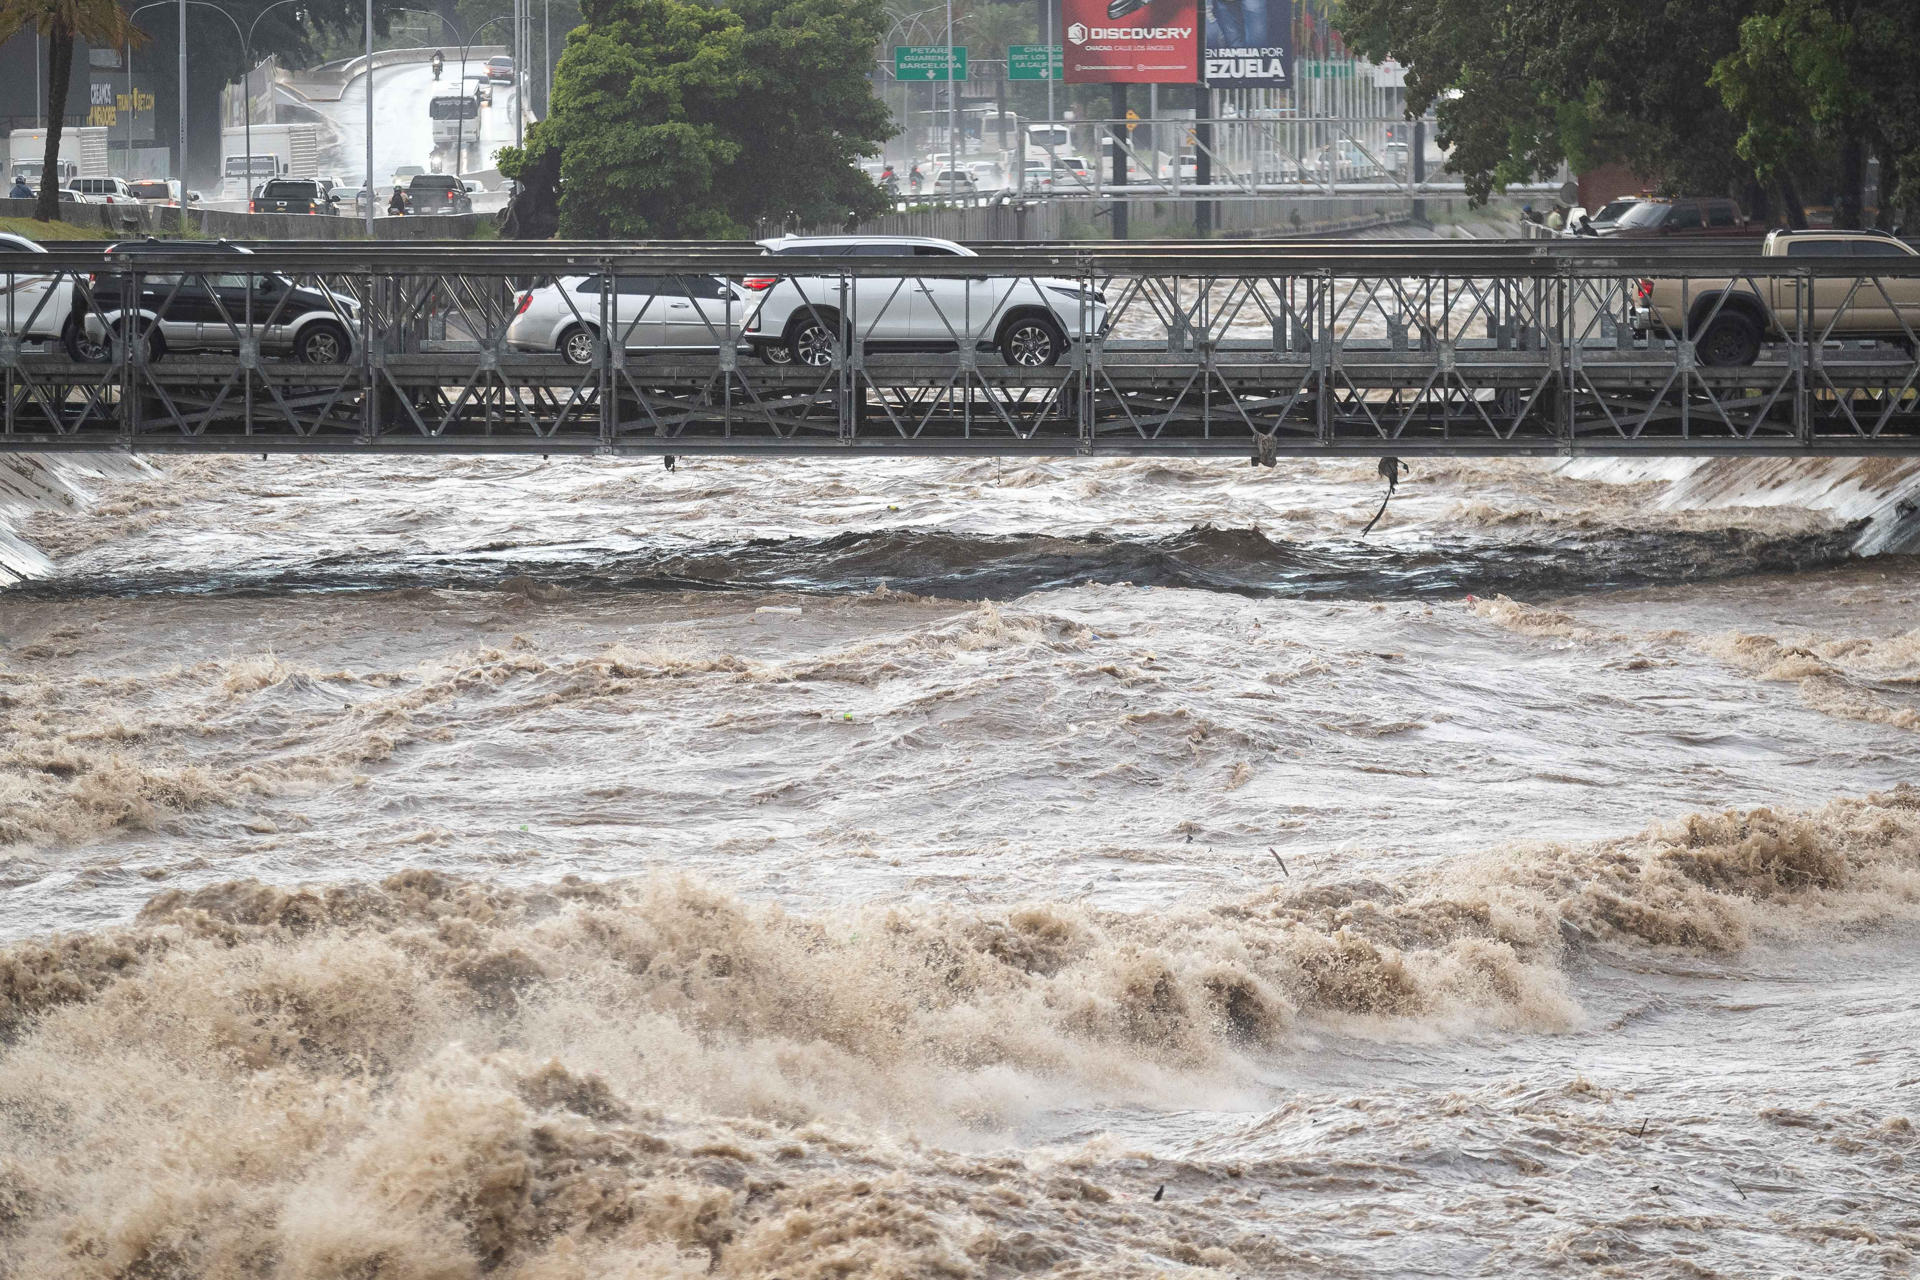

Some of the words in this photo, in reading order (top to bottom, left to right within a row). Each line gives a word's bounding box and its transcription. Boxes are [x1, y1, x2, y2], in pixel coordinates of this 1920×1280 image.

[1091, 28, 1192, 39] DISCOVERY
[1205, 49, 1217, 57] EN
[1219, 48, 1259, 57] FAMILIA
[1261, 47, 1283, 57] POR
[1205, 59, 1285, 78] EZUELA
[91, 84, 111, 104] CREAMOS
